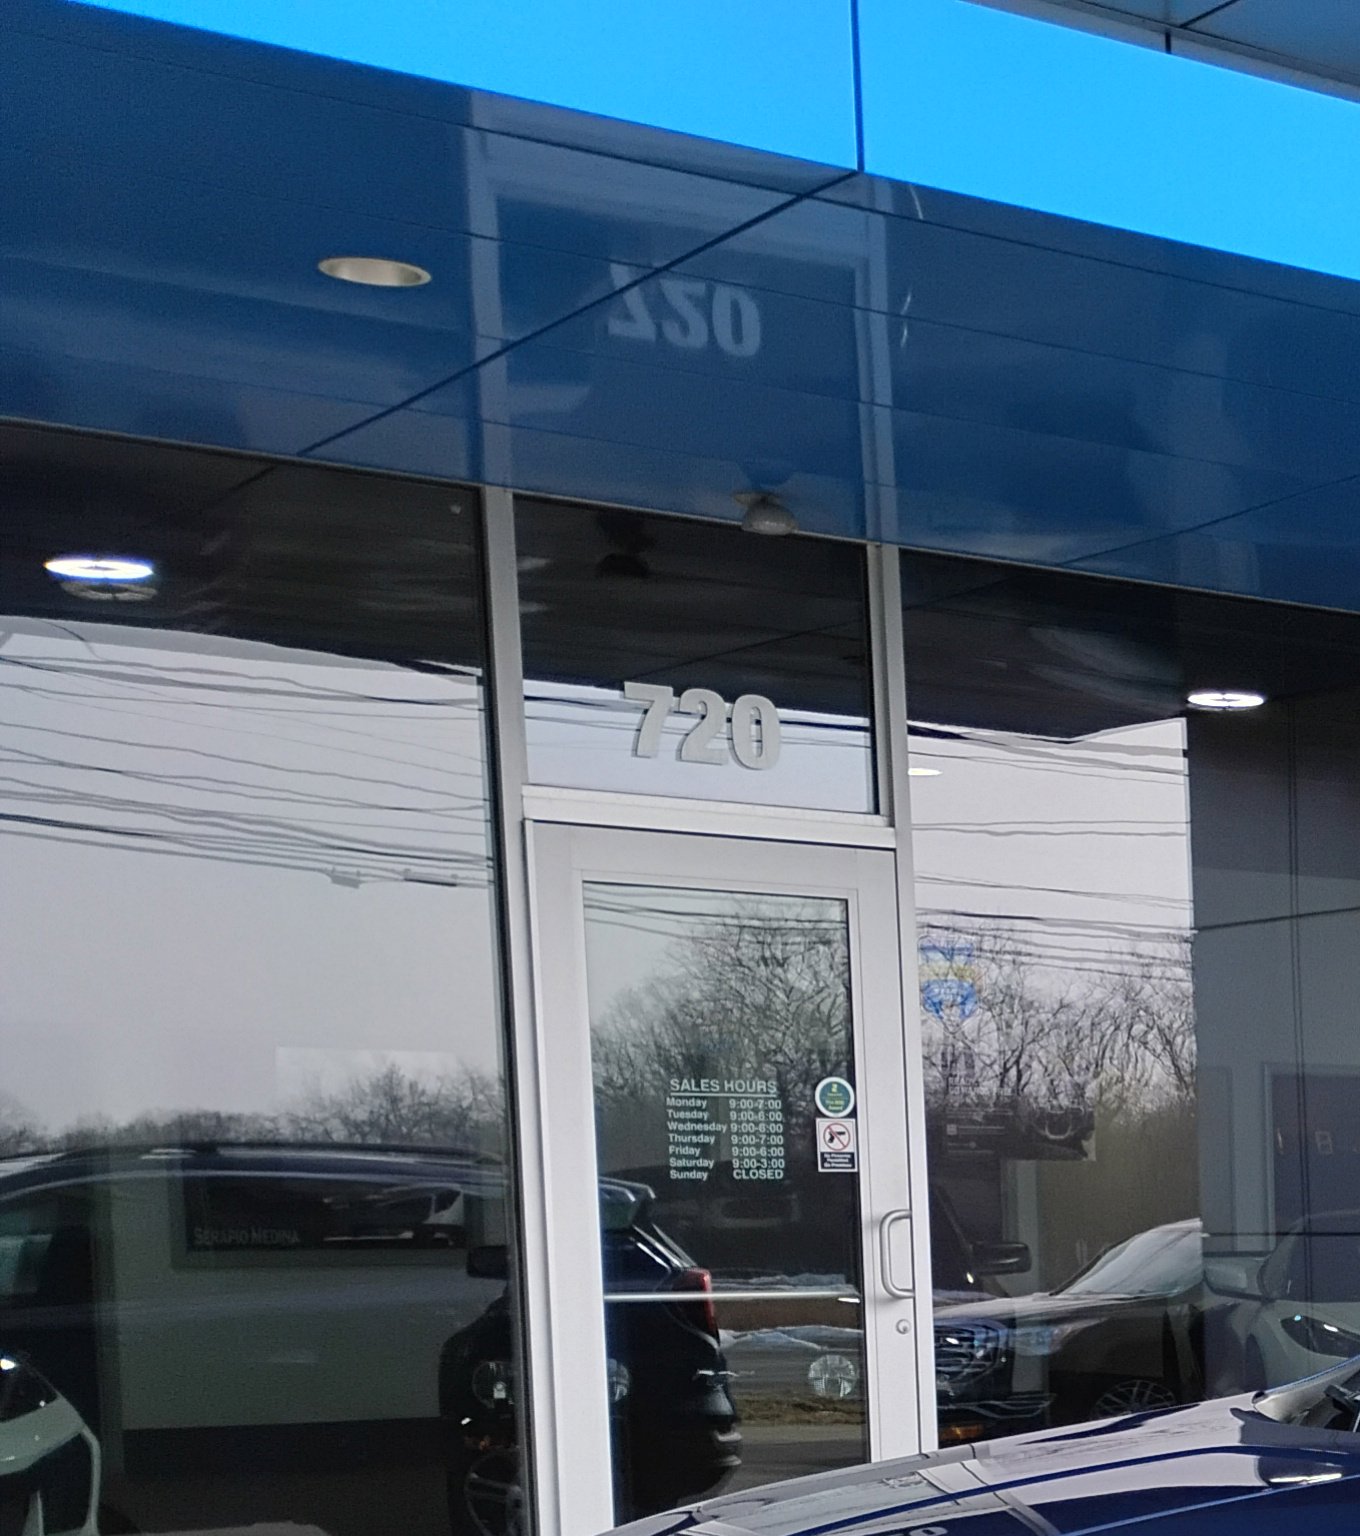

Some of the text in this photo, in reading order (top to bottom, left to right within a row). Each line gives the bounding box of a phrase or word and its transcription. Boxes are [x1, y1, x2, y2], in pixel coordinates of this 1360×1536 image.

[623, 680, 782, 771] 720
[670, 1079, 778, 1093] SALES HOURS
[666, 1097, 782, 1110] Monday 9:00-7:00
[667, 1109, 783, 1122] Tuesday 9:00-6:00
[667, 1122, 783, 1134] Wednesday 9:00-6:00
[668, 1133, 784, 1145] Thursday 9:00-7:00
[669, 1145, 784, 1157] Friday 9:00-6:00
[669, 1157, 785, 1169] Saturday 9:00-3:00
[670, 1169, 784, 1181] Sunday CLOSED
